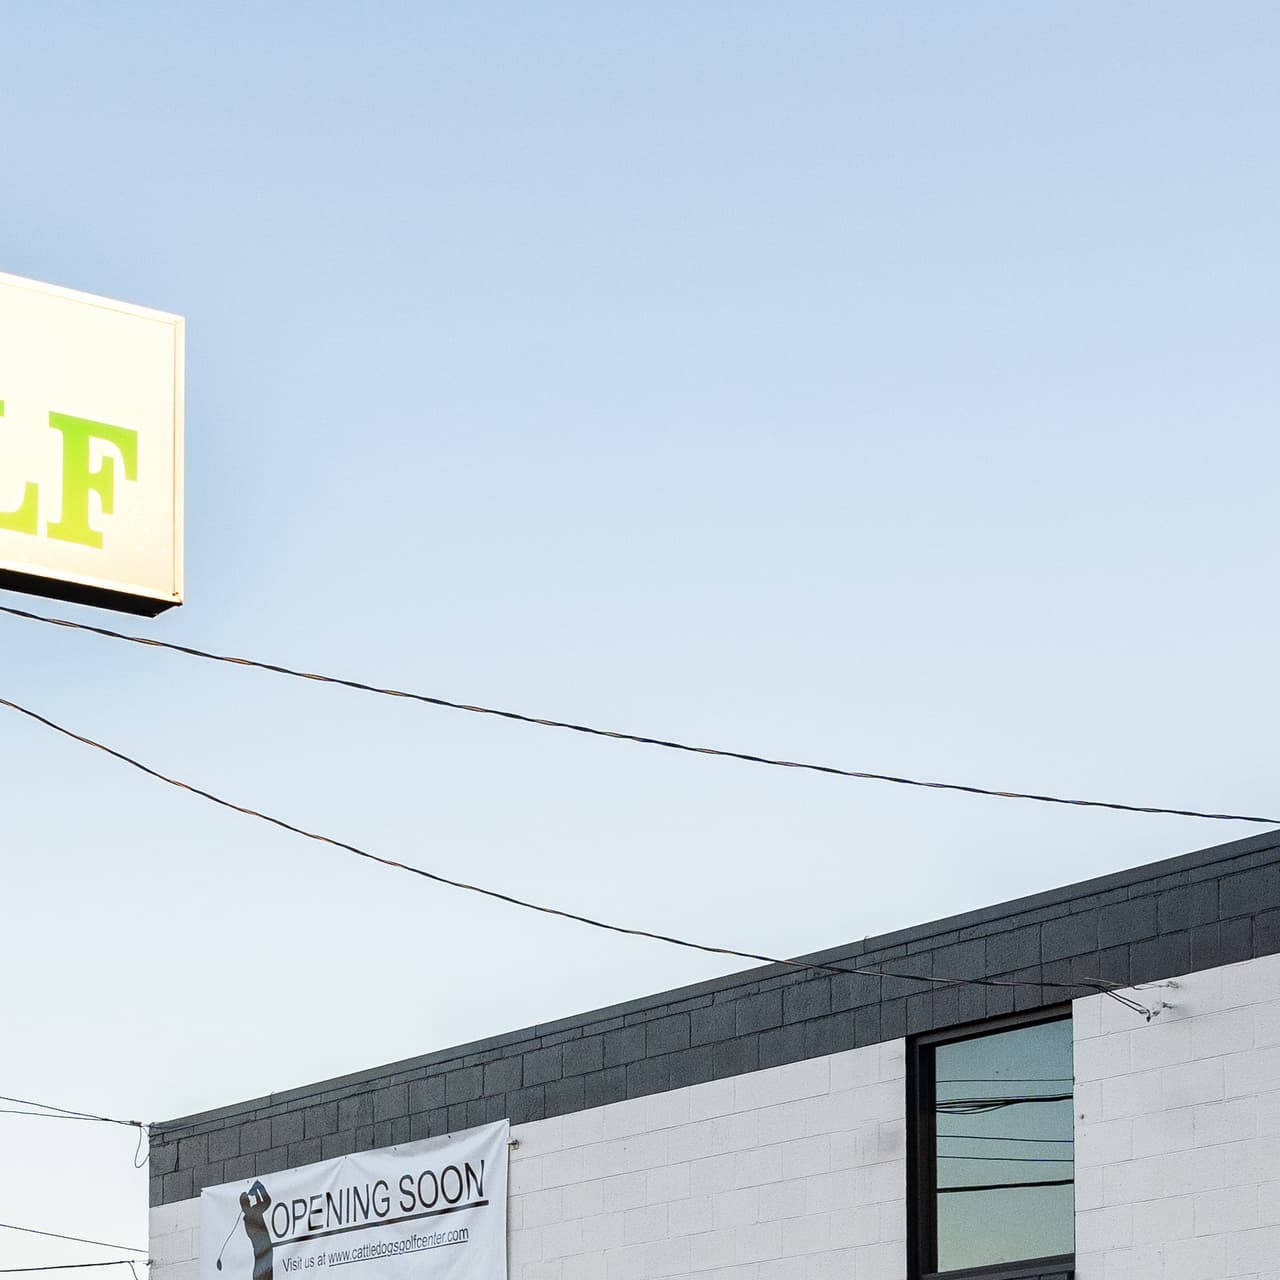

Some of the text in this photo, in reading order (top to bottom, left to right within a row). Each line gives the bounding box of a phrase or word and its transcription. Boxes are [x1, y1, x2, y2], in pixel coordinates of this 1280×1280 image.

[271, 1159, 485, 1239] OPENING SOON
[282, 1226, 469, 1273] Visit us at www.cattledogsgolfcenter.com
